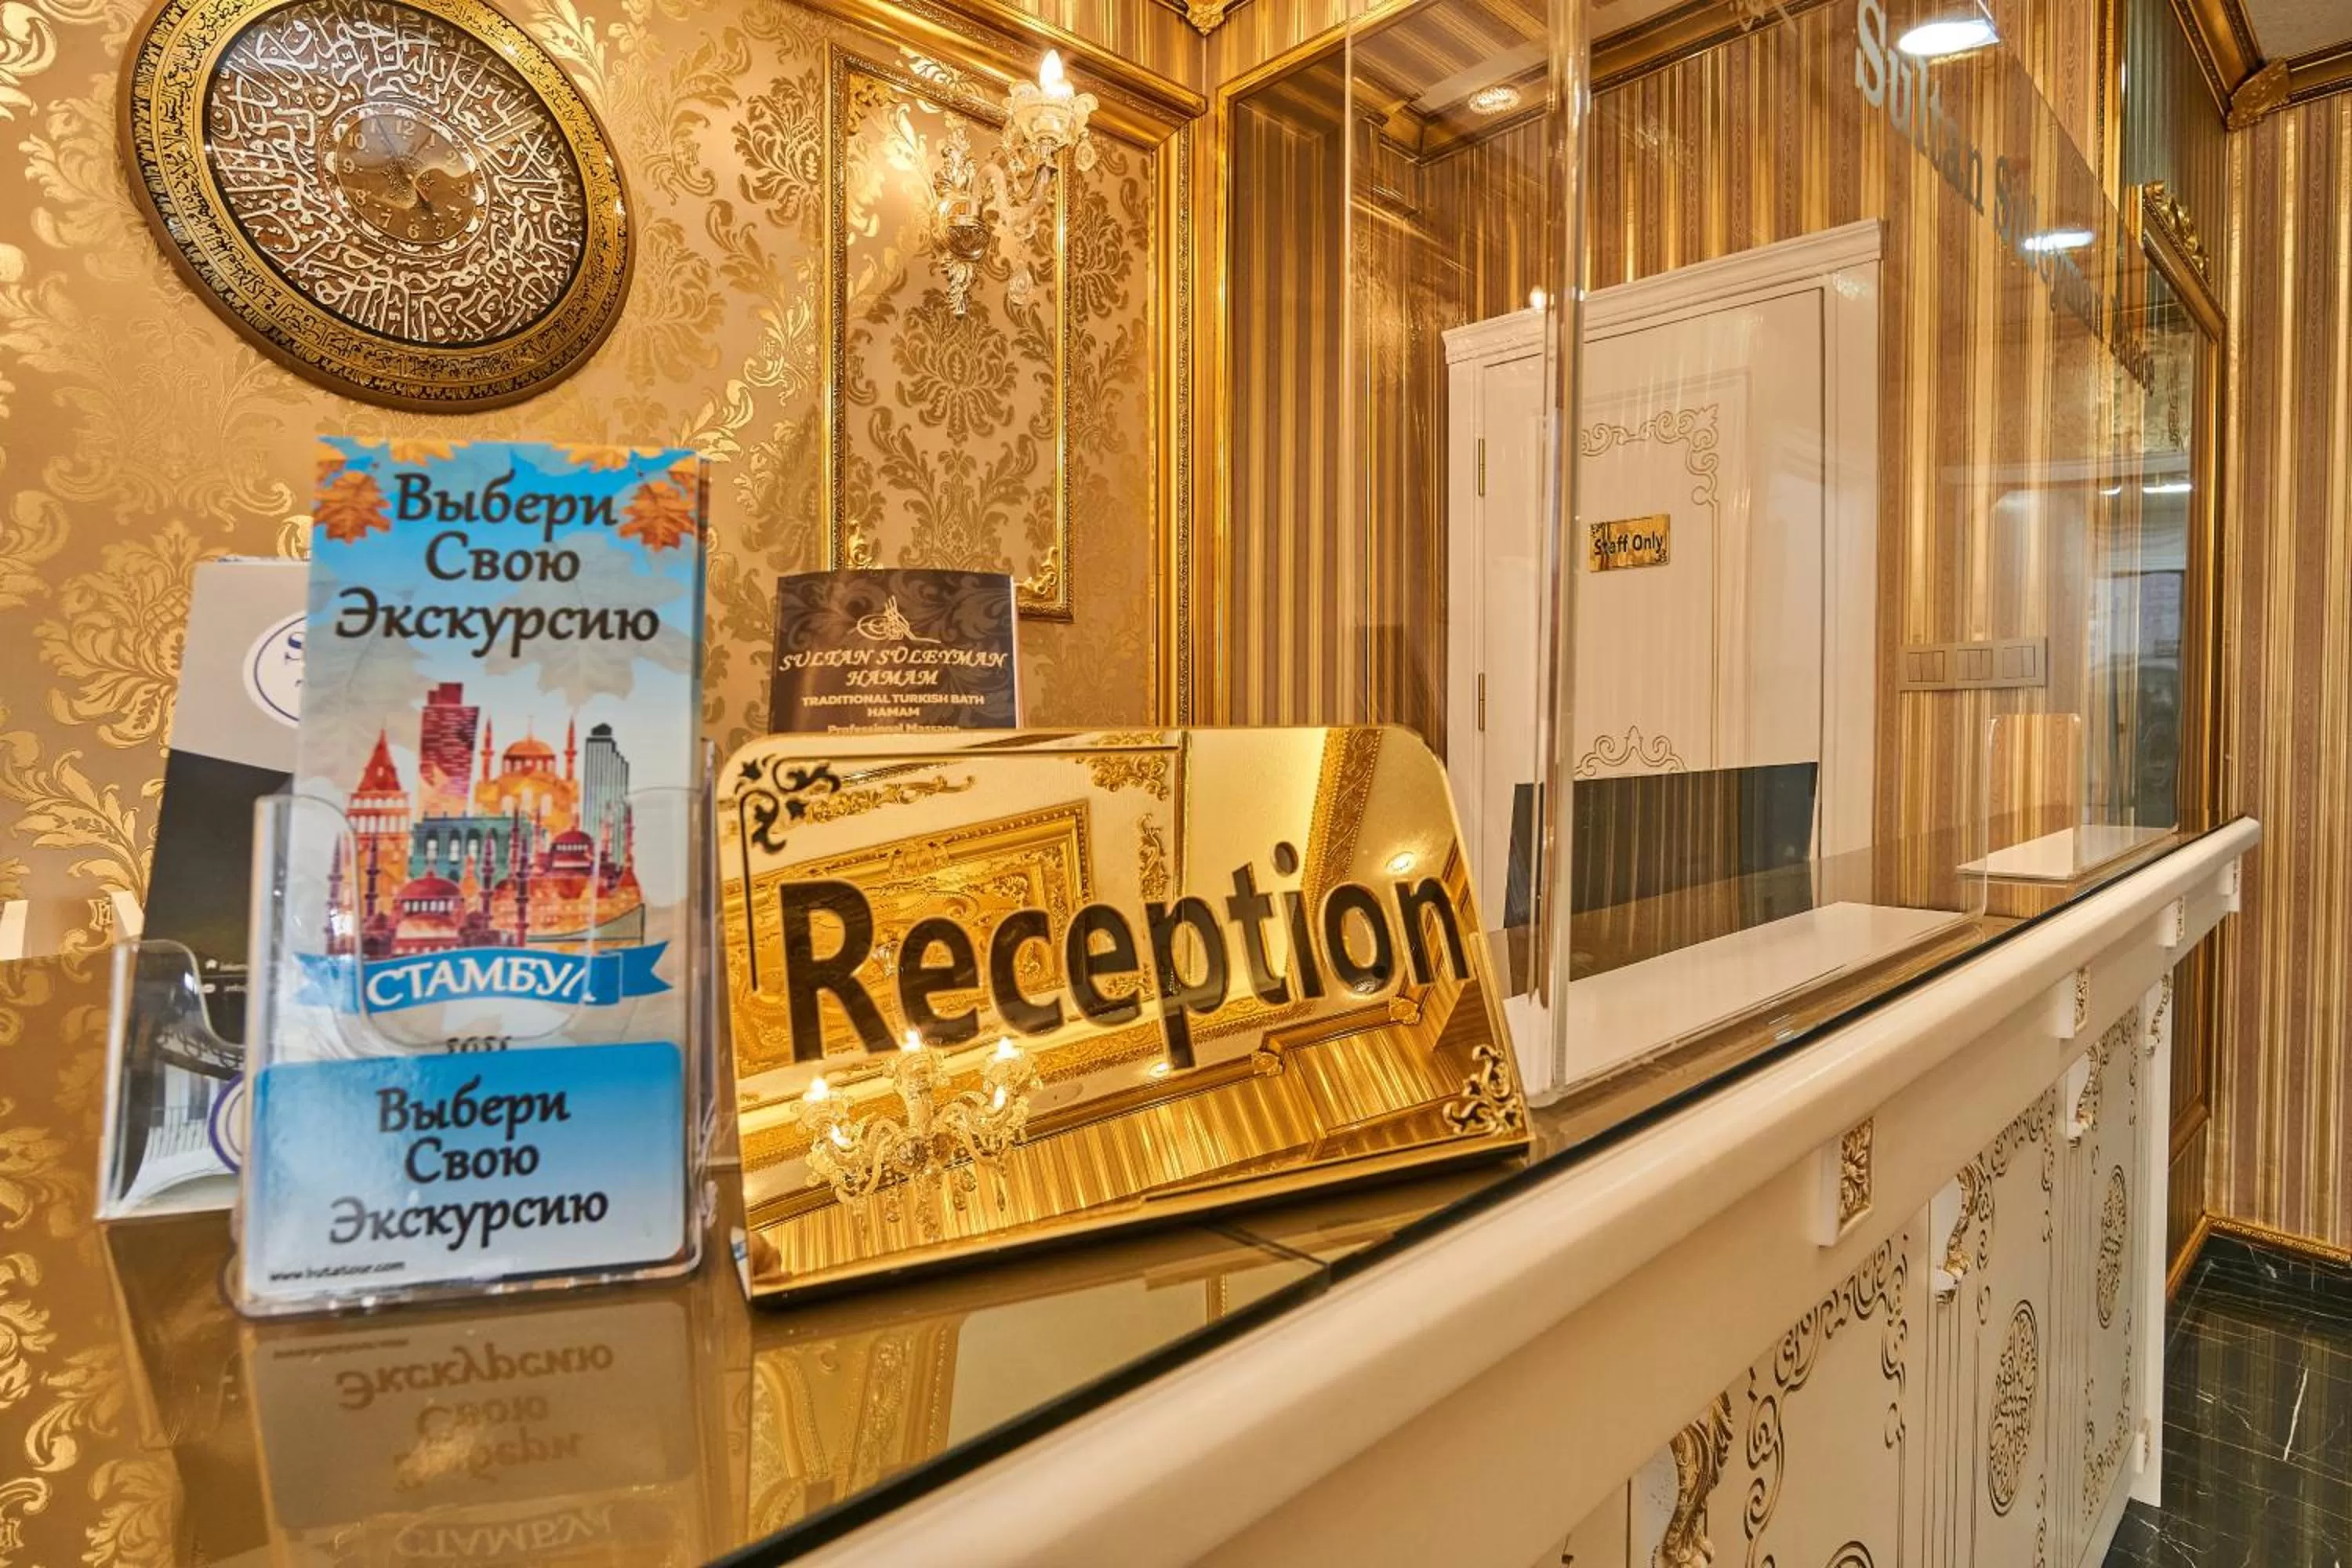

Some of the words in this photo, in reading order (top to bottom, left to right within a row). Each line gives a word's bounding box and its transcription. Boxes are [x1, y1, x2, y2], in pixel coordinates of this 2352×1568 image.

[394, 468, 618, 541] Выбери
[425, 532, 580, 582] Свою
[1594, 533, 1628, 556] Staff
[1632, 530, 1663, 554] Only
[336, 586, 660, 657] Экскурсию
[779, 648, 873, 671] SULTAN
[846, 670, 938, 687] HAMAM
[803, 694, 891, 706] TRADITIONAL
[893, 694, 949, 704] TURKISH
[951, 695, 985, 705] BATH
[867, 706, 920, 717] HAMAM
[777, 840, 1475, 1069] Reception
[376, 1074, 571, 1141] Выбери
[405, 1136, 540, 1184] Свою
[328, 1191, 609, 1251] Экскурсию
